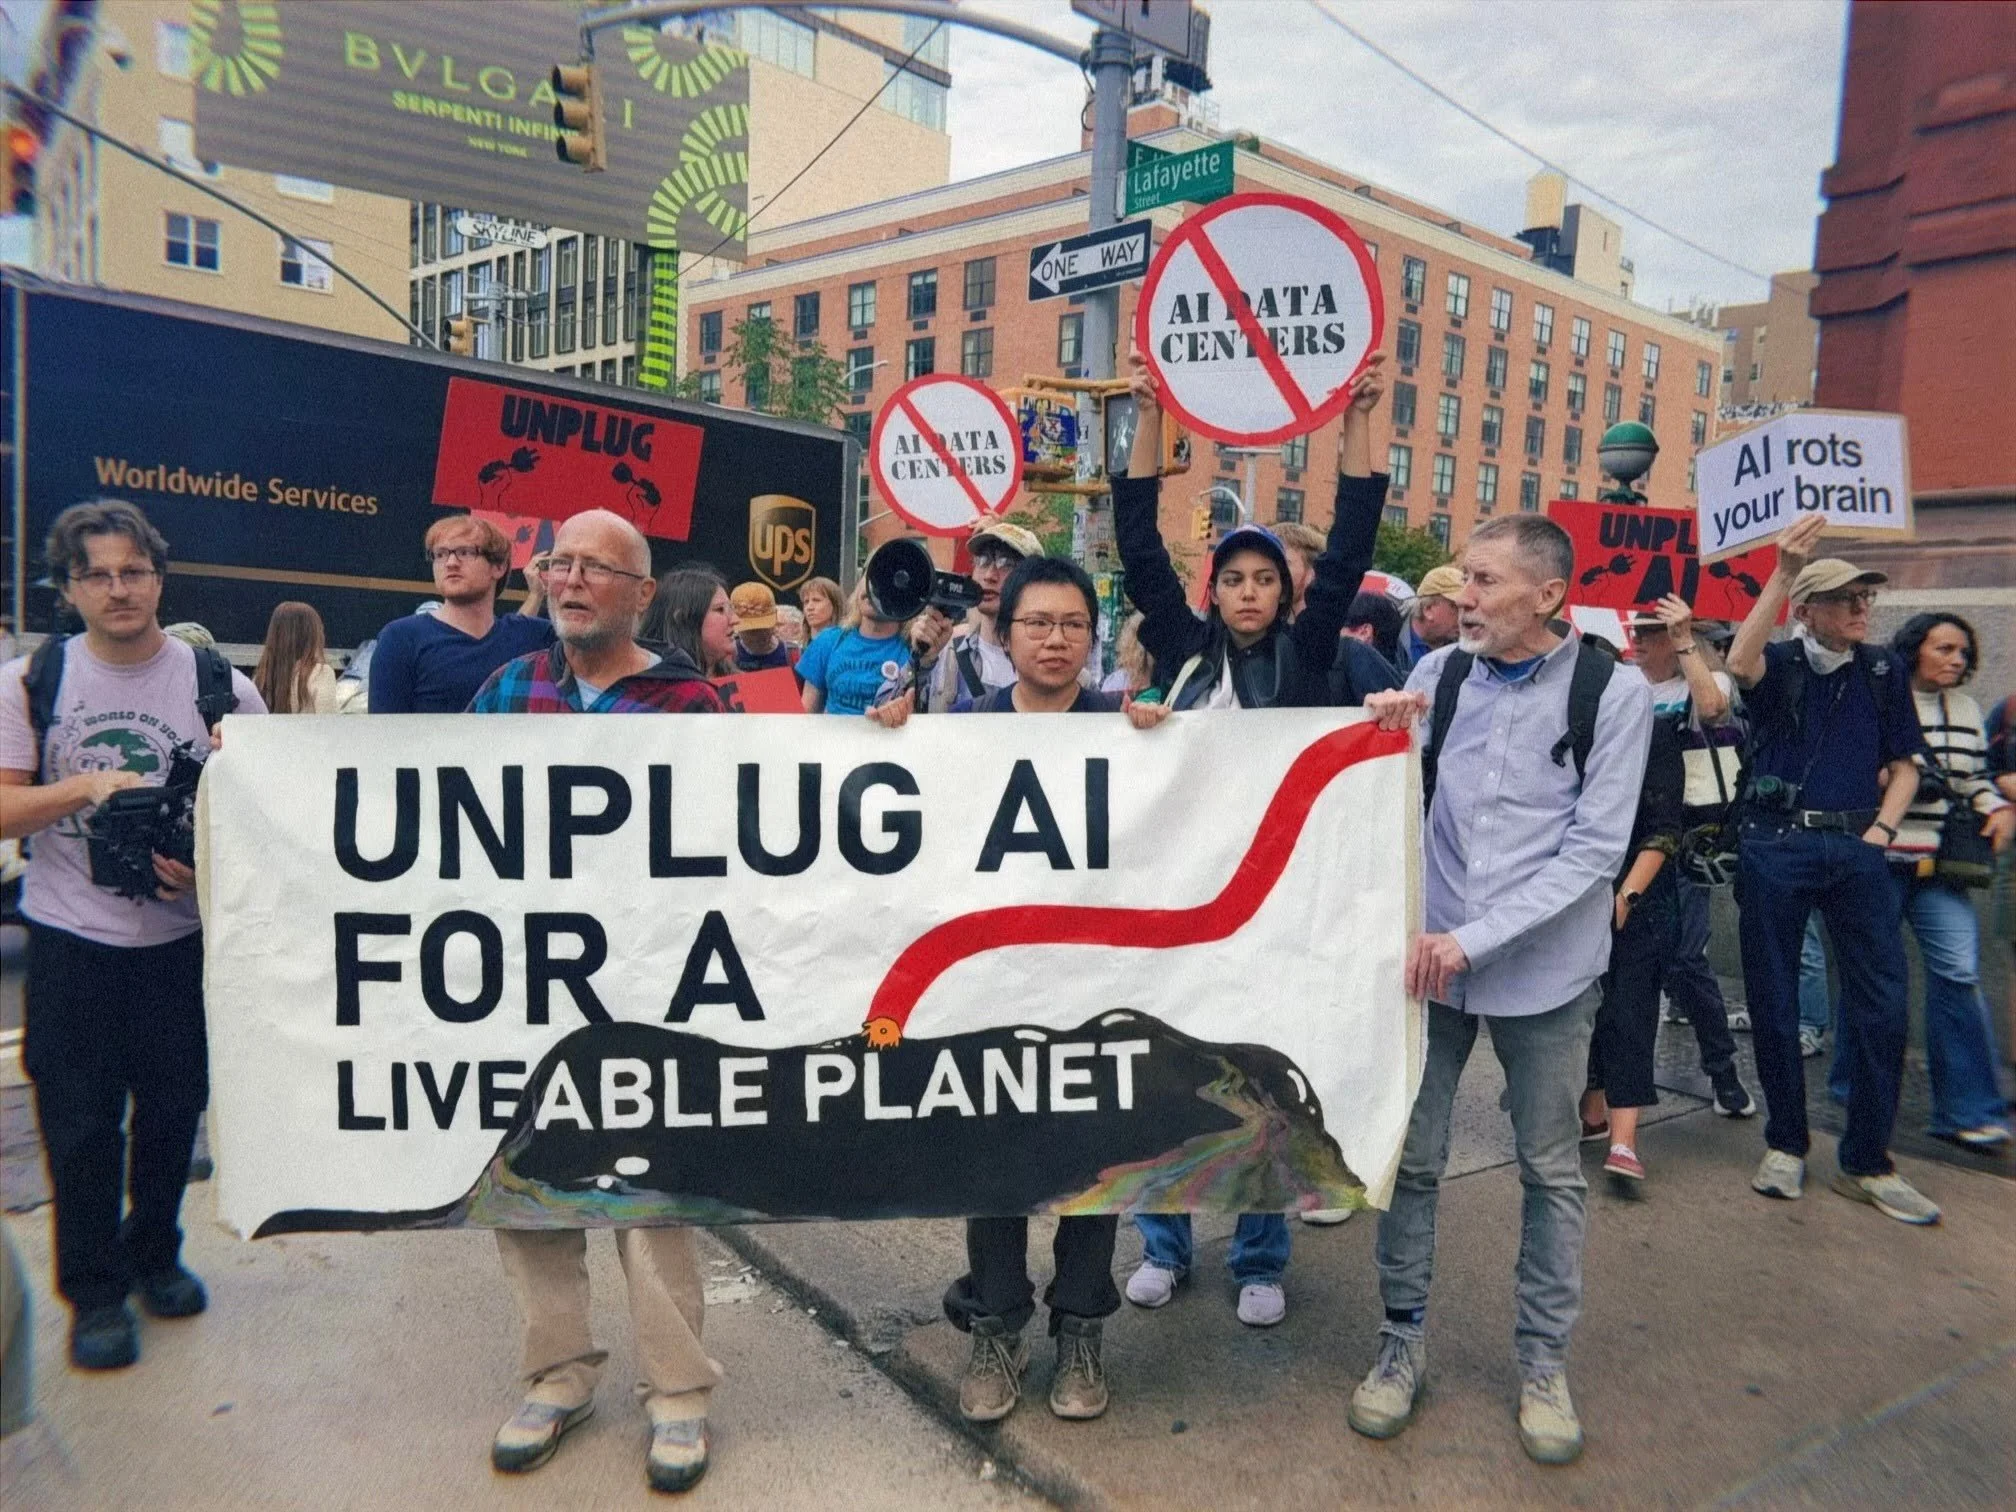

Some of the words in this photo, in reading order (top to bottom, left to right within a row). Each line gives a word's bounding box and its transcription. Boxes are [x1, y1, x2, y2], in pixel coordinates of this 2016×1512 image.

[343, 31, 633, 130] BVLGAI
[392, 90, 502, 130] SERPENTI
[1134, 152, 1220, 194] Lafayette
[1041, 254, 1078, 281] ONE
[1101, 239, 1139, 268] WAY
[1168, 292, 1210, 324] AI
[501, 394, 655, 462] UNPLUG
[895, 434, 922, 455] AI
[94, 455, 258, 502] Worldwide
[267, 478, 379, 516] Services
[1734, 435, 1771, 487] AI
[1786, 433, 1862, 468] rots
[1599, 511, 1697, 555] UNPL
[1713, 488, 1785, 546] your
[1795, 475, 1892, 514] brain
[754, 523, 812, 577] ups
[1633, 555, 1699, 610] AI
[84, 711, 136, 727] WORLD
[334, 761, 922, 883] UNPLUG
[976, 758, 1108, 871] AI
[333, 909, 612, 1026] FOR
[664, 910, 766, 1023] A
[337, 1056, 769, 1131] LIVEABLE
[805, 1038, 1150, 1125] PLANET
